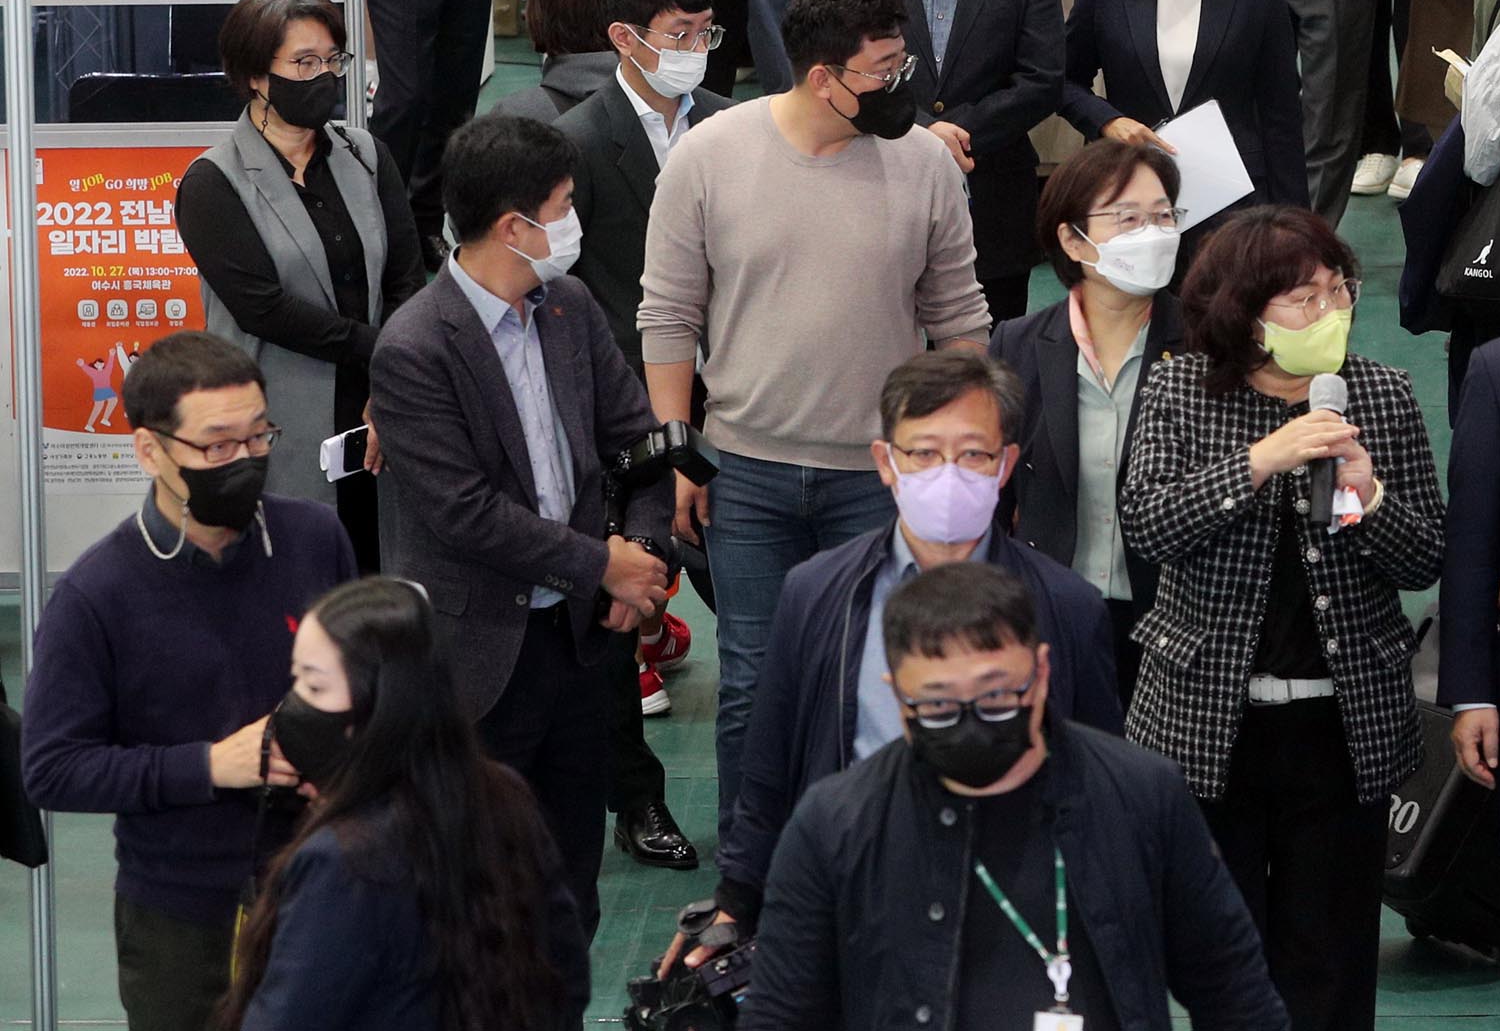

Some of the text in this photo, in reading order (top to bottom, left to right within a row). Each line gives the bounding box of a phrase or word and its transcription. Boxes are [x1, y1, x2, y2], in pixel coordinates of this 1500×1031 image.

[81, 173, 104, 192] JOB
[105, 179, 123, 190] GO
[126, 178, 148, 191] 희망
[150, 172, 173, 191] JOB
[36, 200, 175, 225] 2022 전남
[49, 230, 189, 255] 일자리 박람
[64, 268, 89, 276] 2022.
[91, 266, 106, 276] 10.
[110, 266, 125, 276] 27.
[146, 267, 198, 276] 13:00~17:00
[1464, 267, 1494, 279] KANGOL
[92, 280, 171, 290] 여수시 흥국체육관
